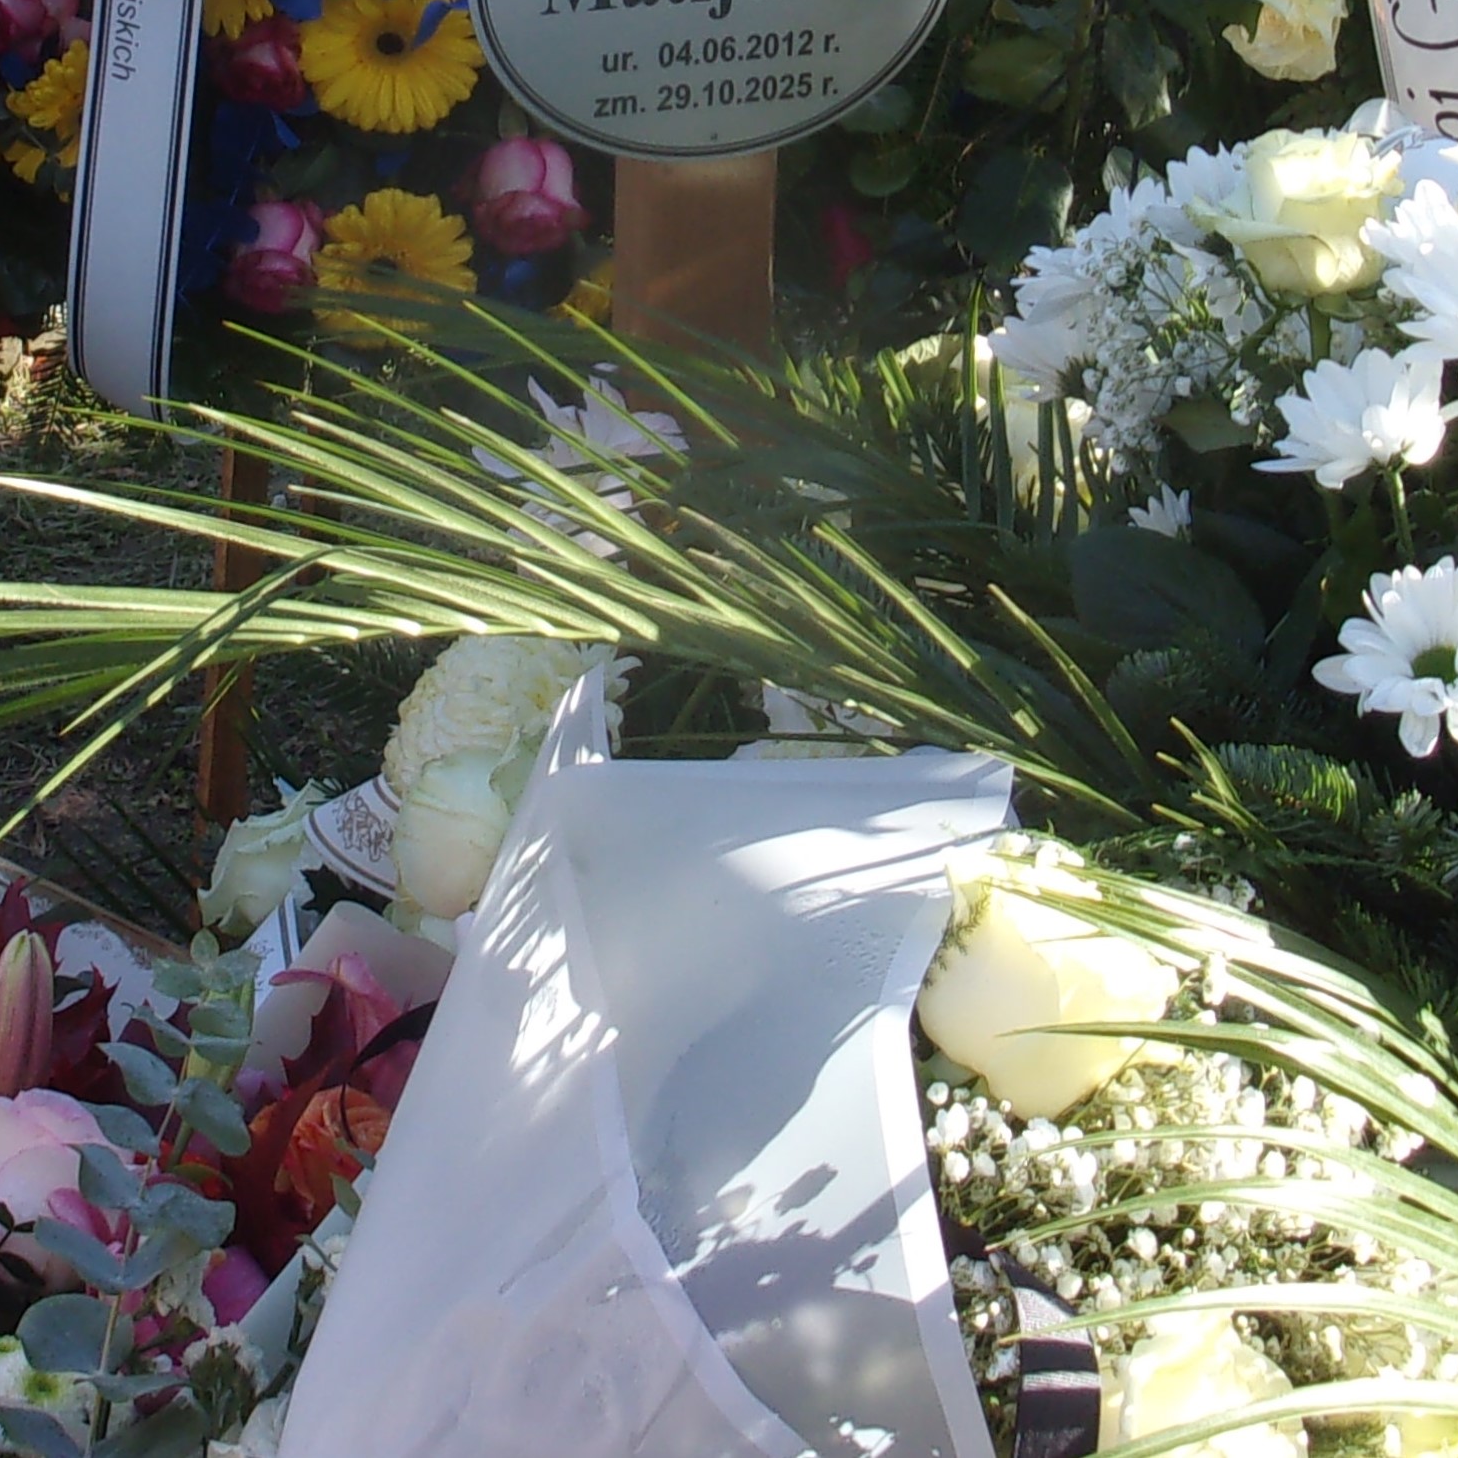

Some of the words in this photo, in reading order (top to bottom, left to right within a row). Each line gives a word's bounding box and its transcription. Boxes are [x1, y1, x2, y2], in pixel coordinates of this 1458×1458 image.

[601, 49, 638, 75] ur.
[658, 31, 814, 68] 04.06.2012
[823, 31, 841, 54] r.
[594, 94, 645, 119] zm.
[657, 73, 812, 112] 29.10.2025
[822, 74, 839, 98] r.
